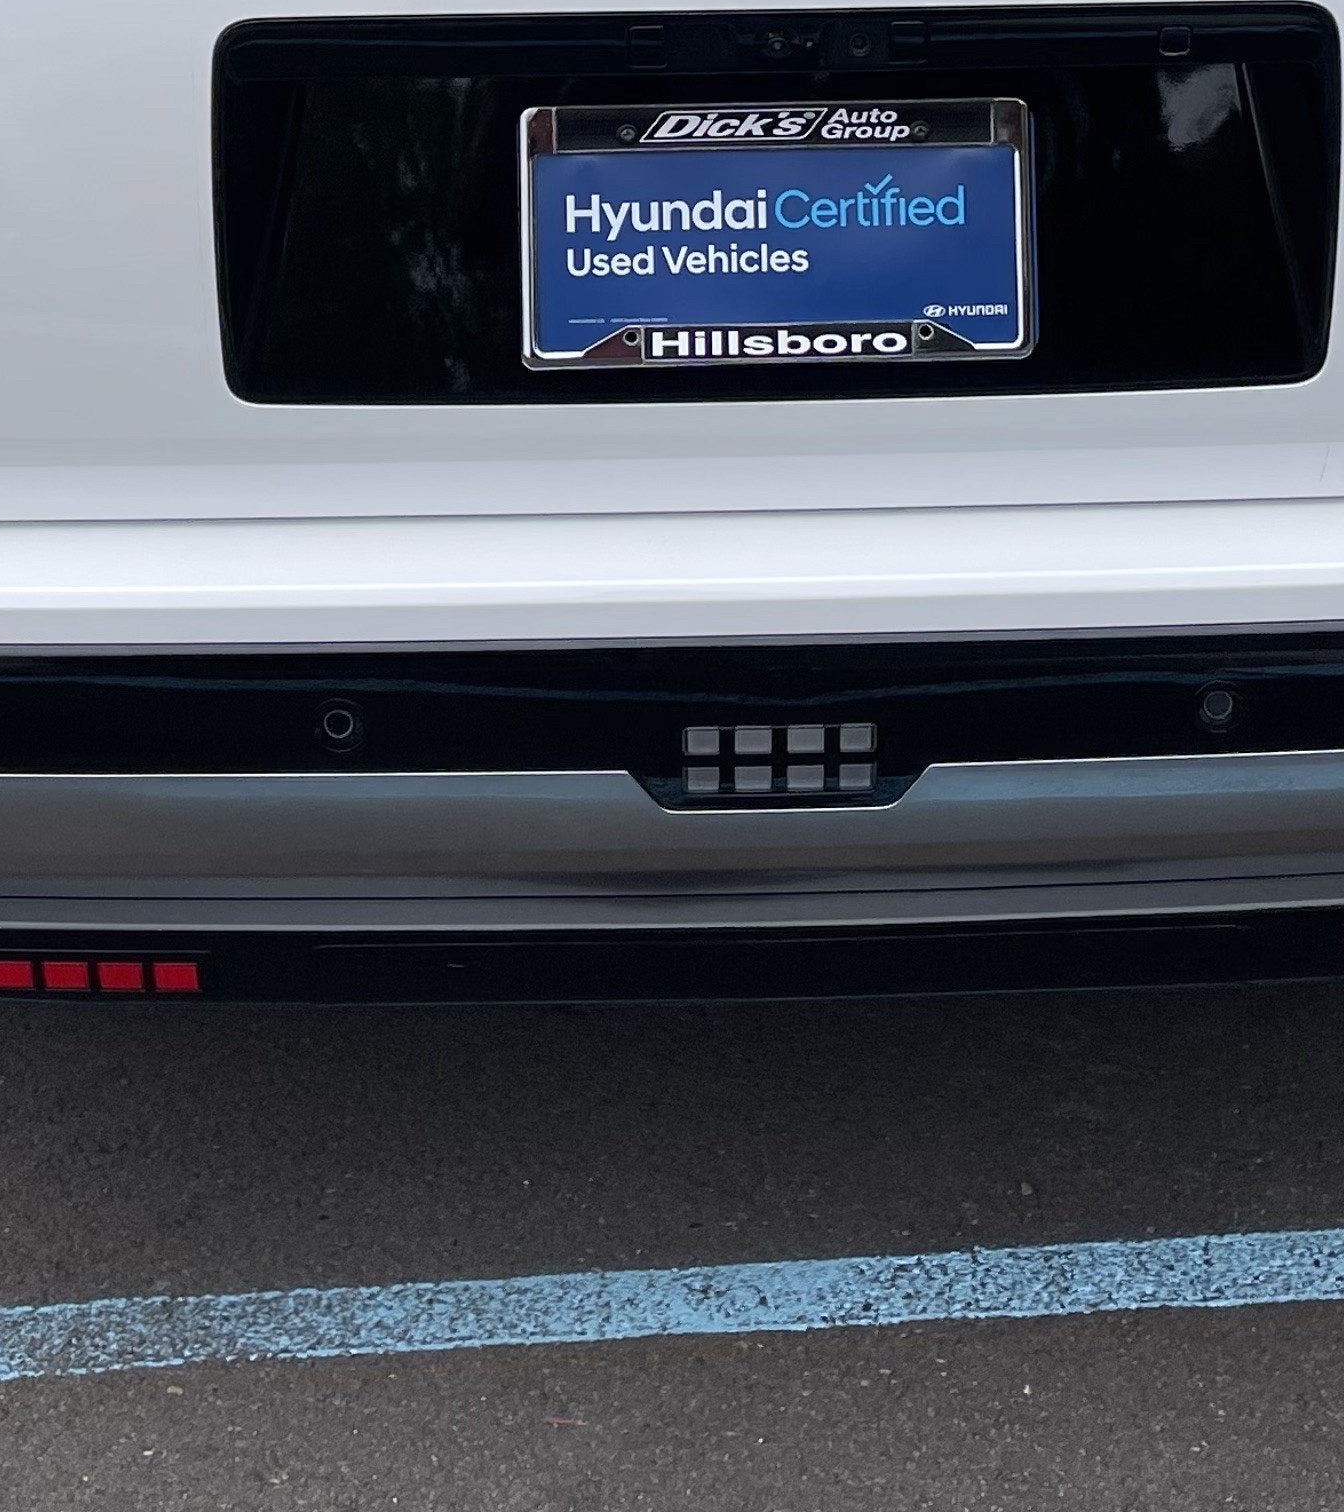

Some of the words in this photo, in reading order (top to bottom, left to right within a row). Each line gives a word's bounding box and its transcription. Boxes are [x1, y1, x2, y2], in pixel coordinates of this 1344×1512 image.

[653, 112, 807, 138] Dick's
[828, 108, 898, 124] Auto
[821, 123, 911, 141] Group
[566, 189, 767, 240] Hyundai
[774, 174, 966, 229] Certified
[566, 247, 655, 276] Used
[662, 245, 809, 274] Vehicles
[948, 304, 1008, 316] HYUNDAI
[652, 330, 908, 356] Hillsboro
